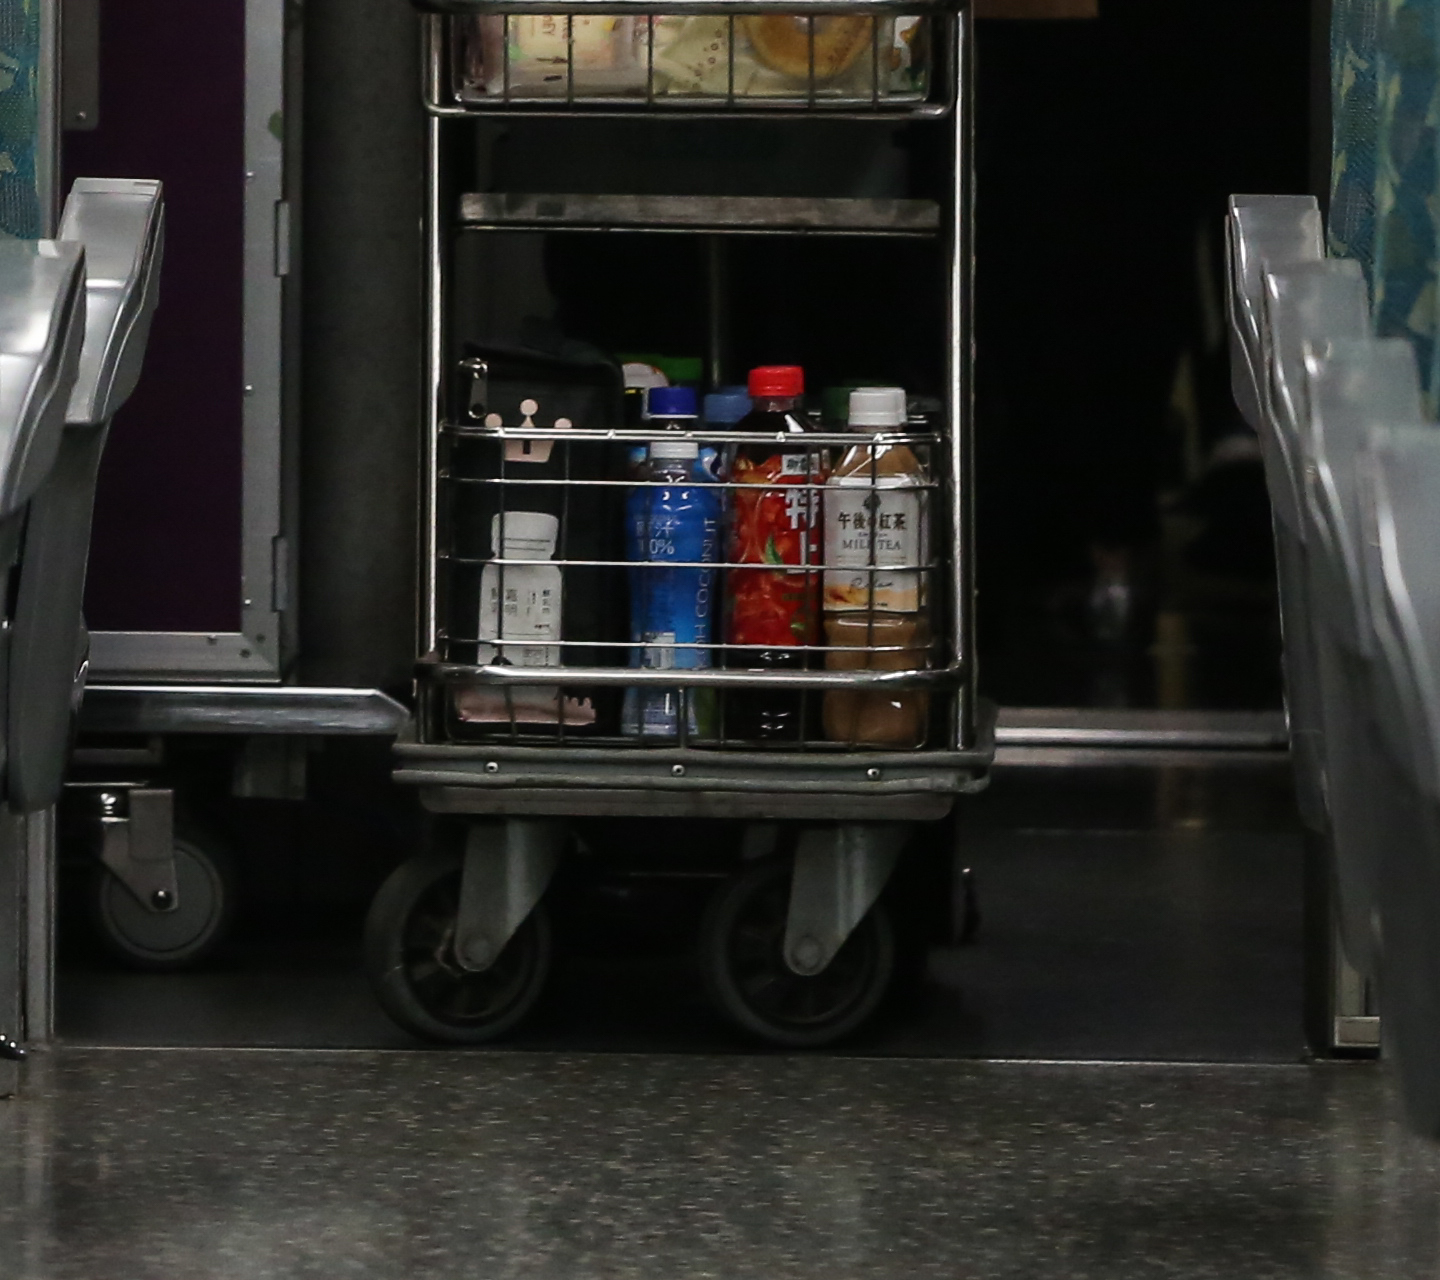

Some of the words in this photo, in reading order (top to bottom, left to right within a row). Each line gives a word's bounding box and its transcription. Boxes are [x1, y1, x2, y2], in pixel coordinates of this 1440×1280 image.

[838, 512, 907, 530] 午後紅茶
[842, 539, 872, 551] MIL
[878, 539, 903, 551] TEA
